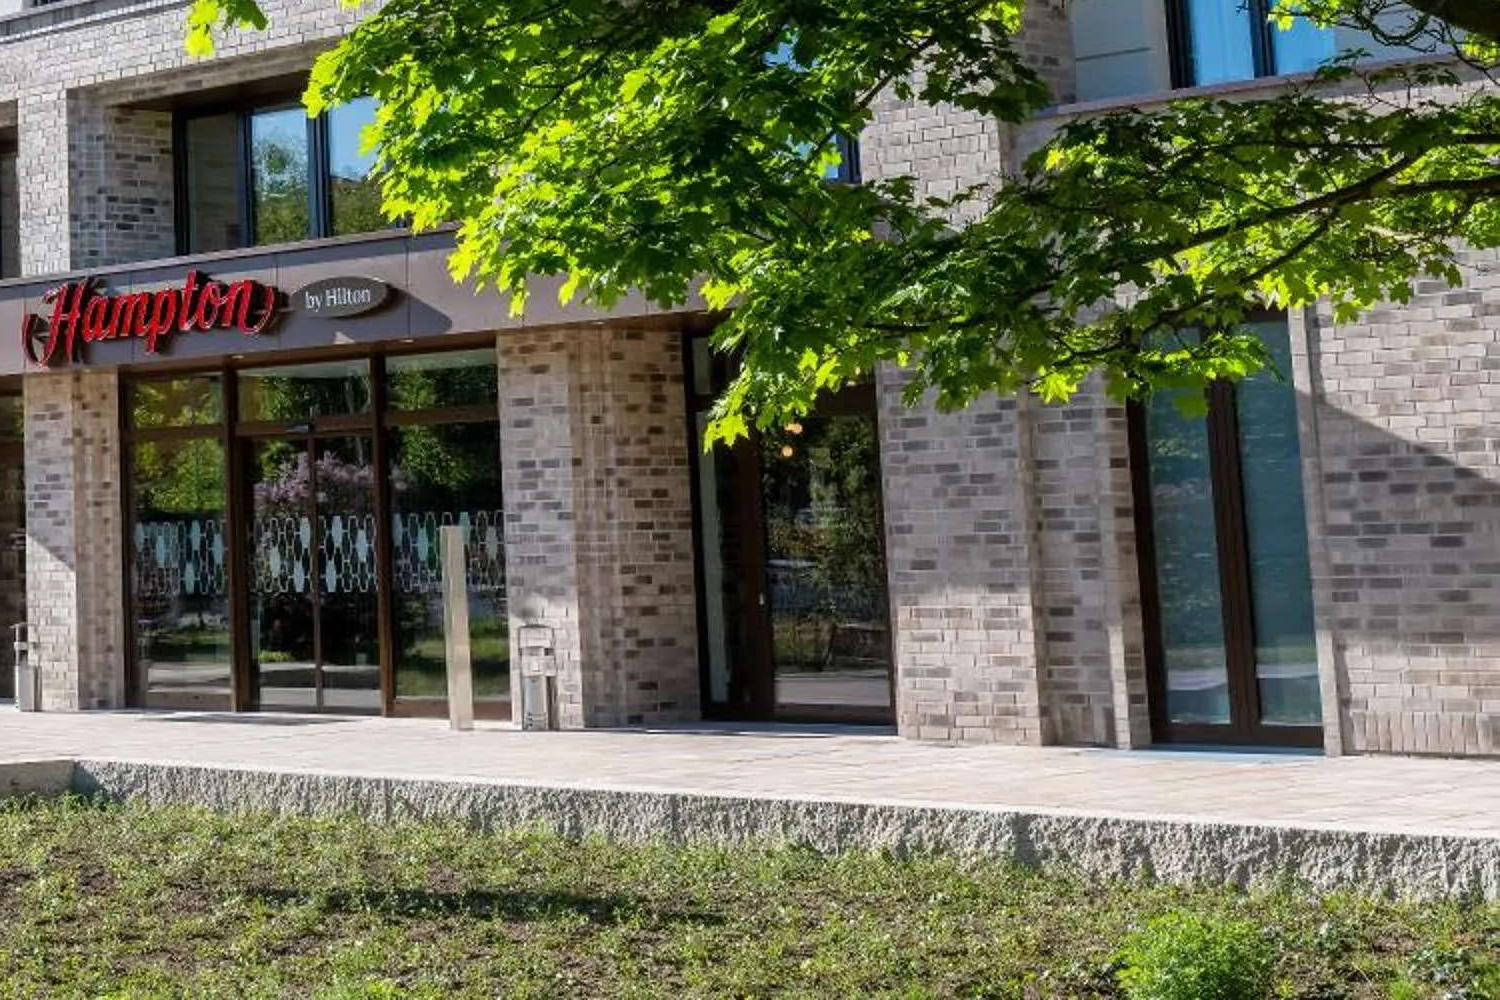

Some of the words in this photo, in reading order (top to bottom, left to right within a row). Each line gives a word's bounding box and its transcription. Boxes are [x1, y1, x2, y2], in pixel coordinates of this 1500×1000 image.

[22, 269, 276, 368] Hampton
[305, 291, 321, 312] by
[325, 287, 371, 306] Hilton
